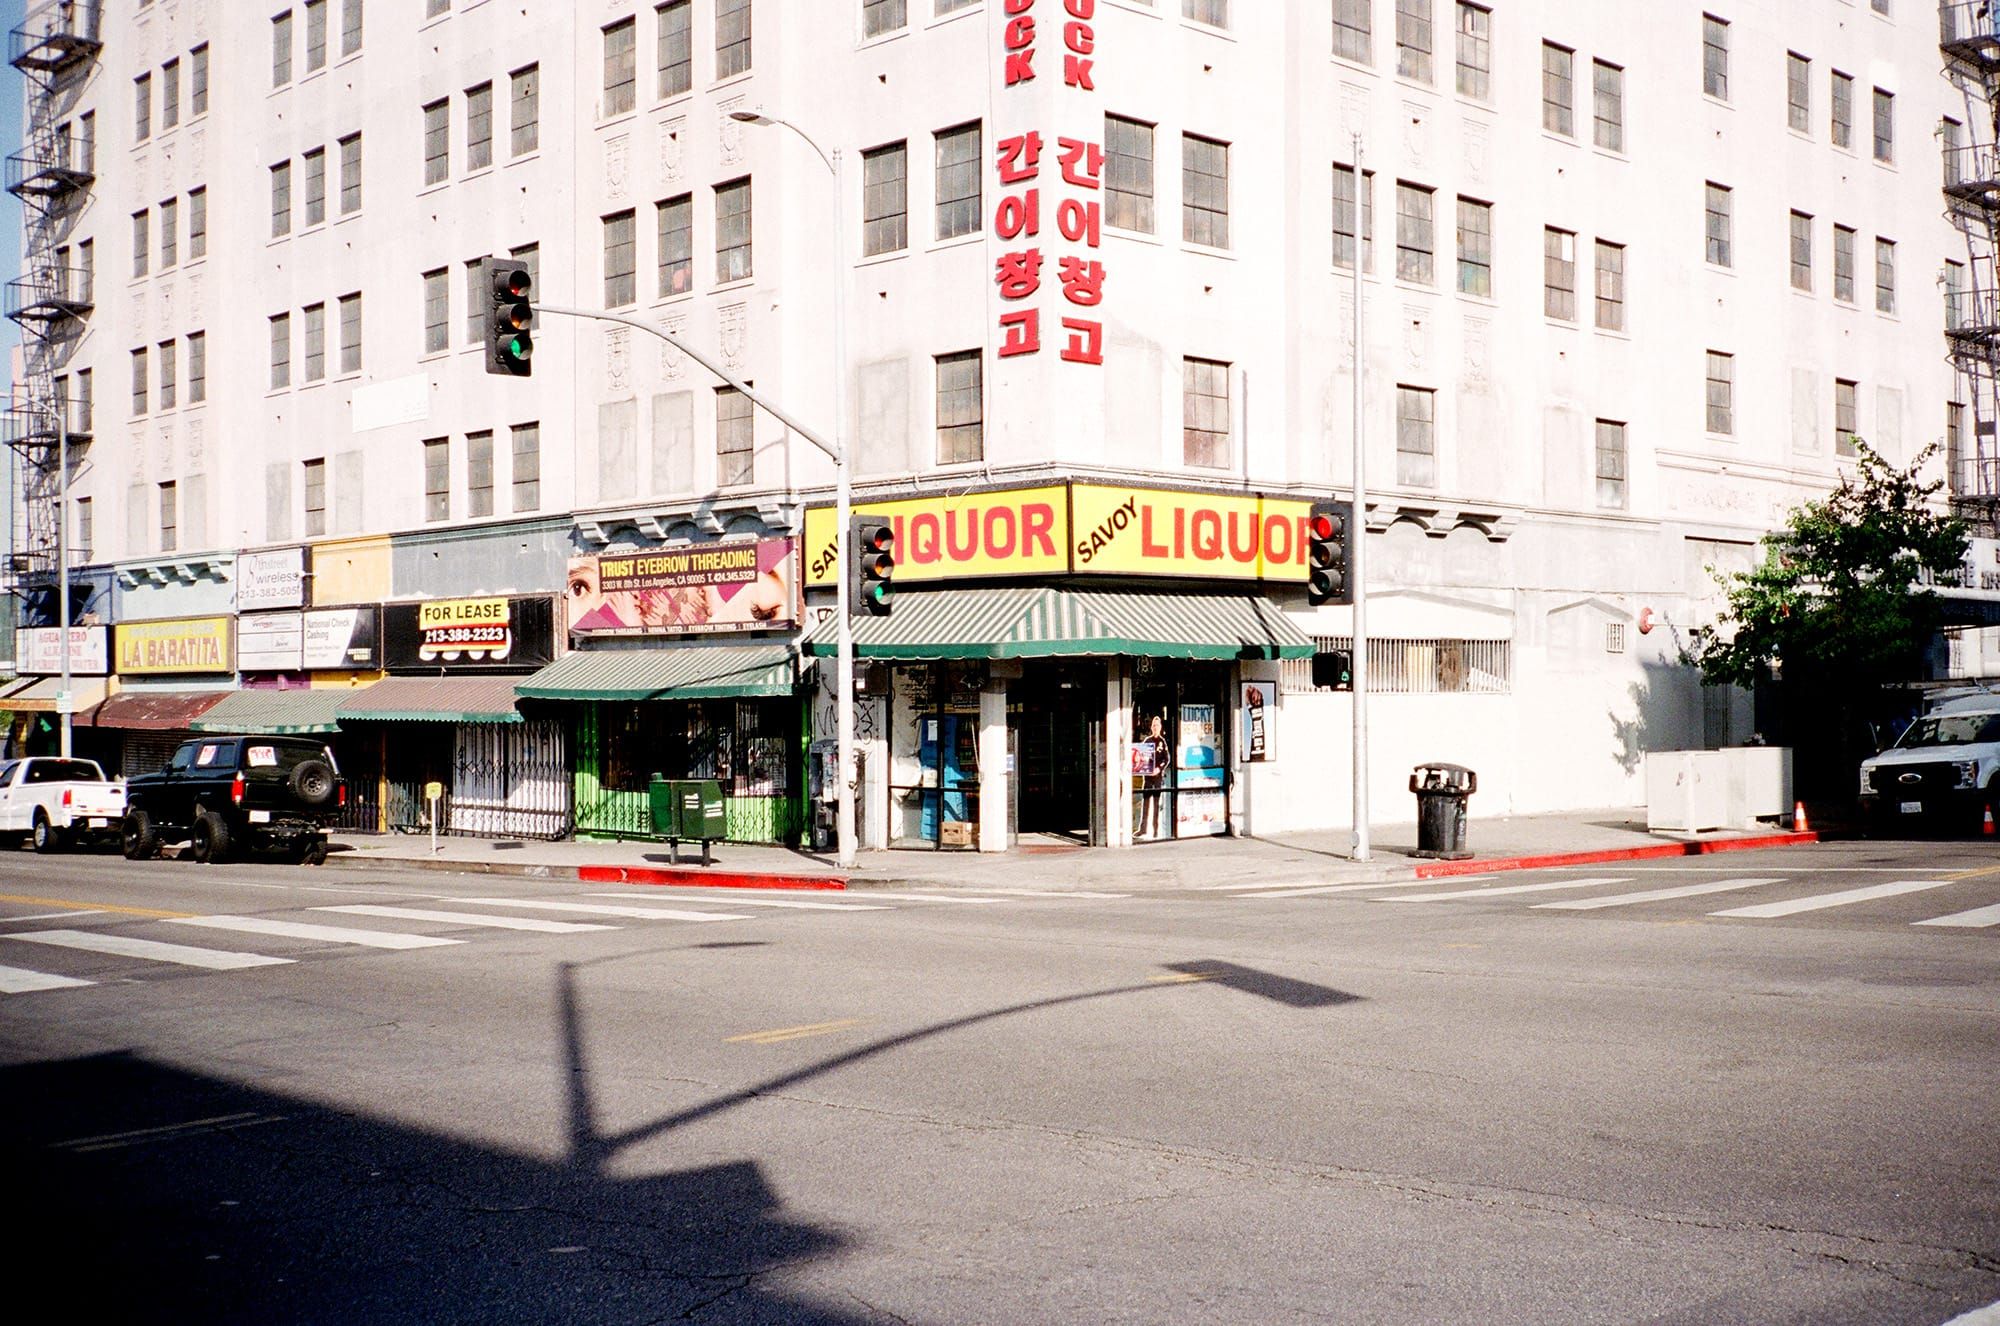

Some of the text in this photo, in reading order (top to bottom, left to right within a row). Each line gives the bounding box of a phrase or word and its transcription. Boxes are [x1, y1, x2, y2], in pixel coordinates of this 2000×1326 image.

[995, 130, 1043, 357] 간이창고
[1056, 135, 1106, 365] 간이창고
[893, 503, 1057, 565] IQUOR
[1077, 495, 1138, 563] SAVOY
[601, 550, 756, 577] TRUST EYEBROW THREADING
[256, 571, 298, 584] wireless
[642, 577, 652, 587] Los
[677, 576, 686, 585] CA
[425, 604, 502, 620] FOR LEASE
[426, 627, 504, 643] 213-388-2323
[123, 636, 221, 668] LA BARATITA
[1183, 706, 1213, 722] LUCKY
